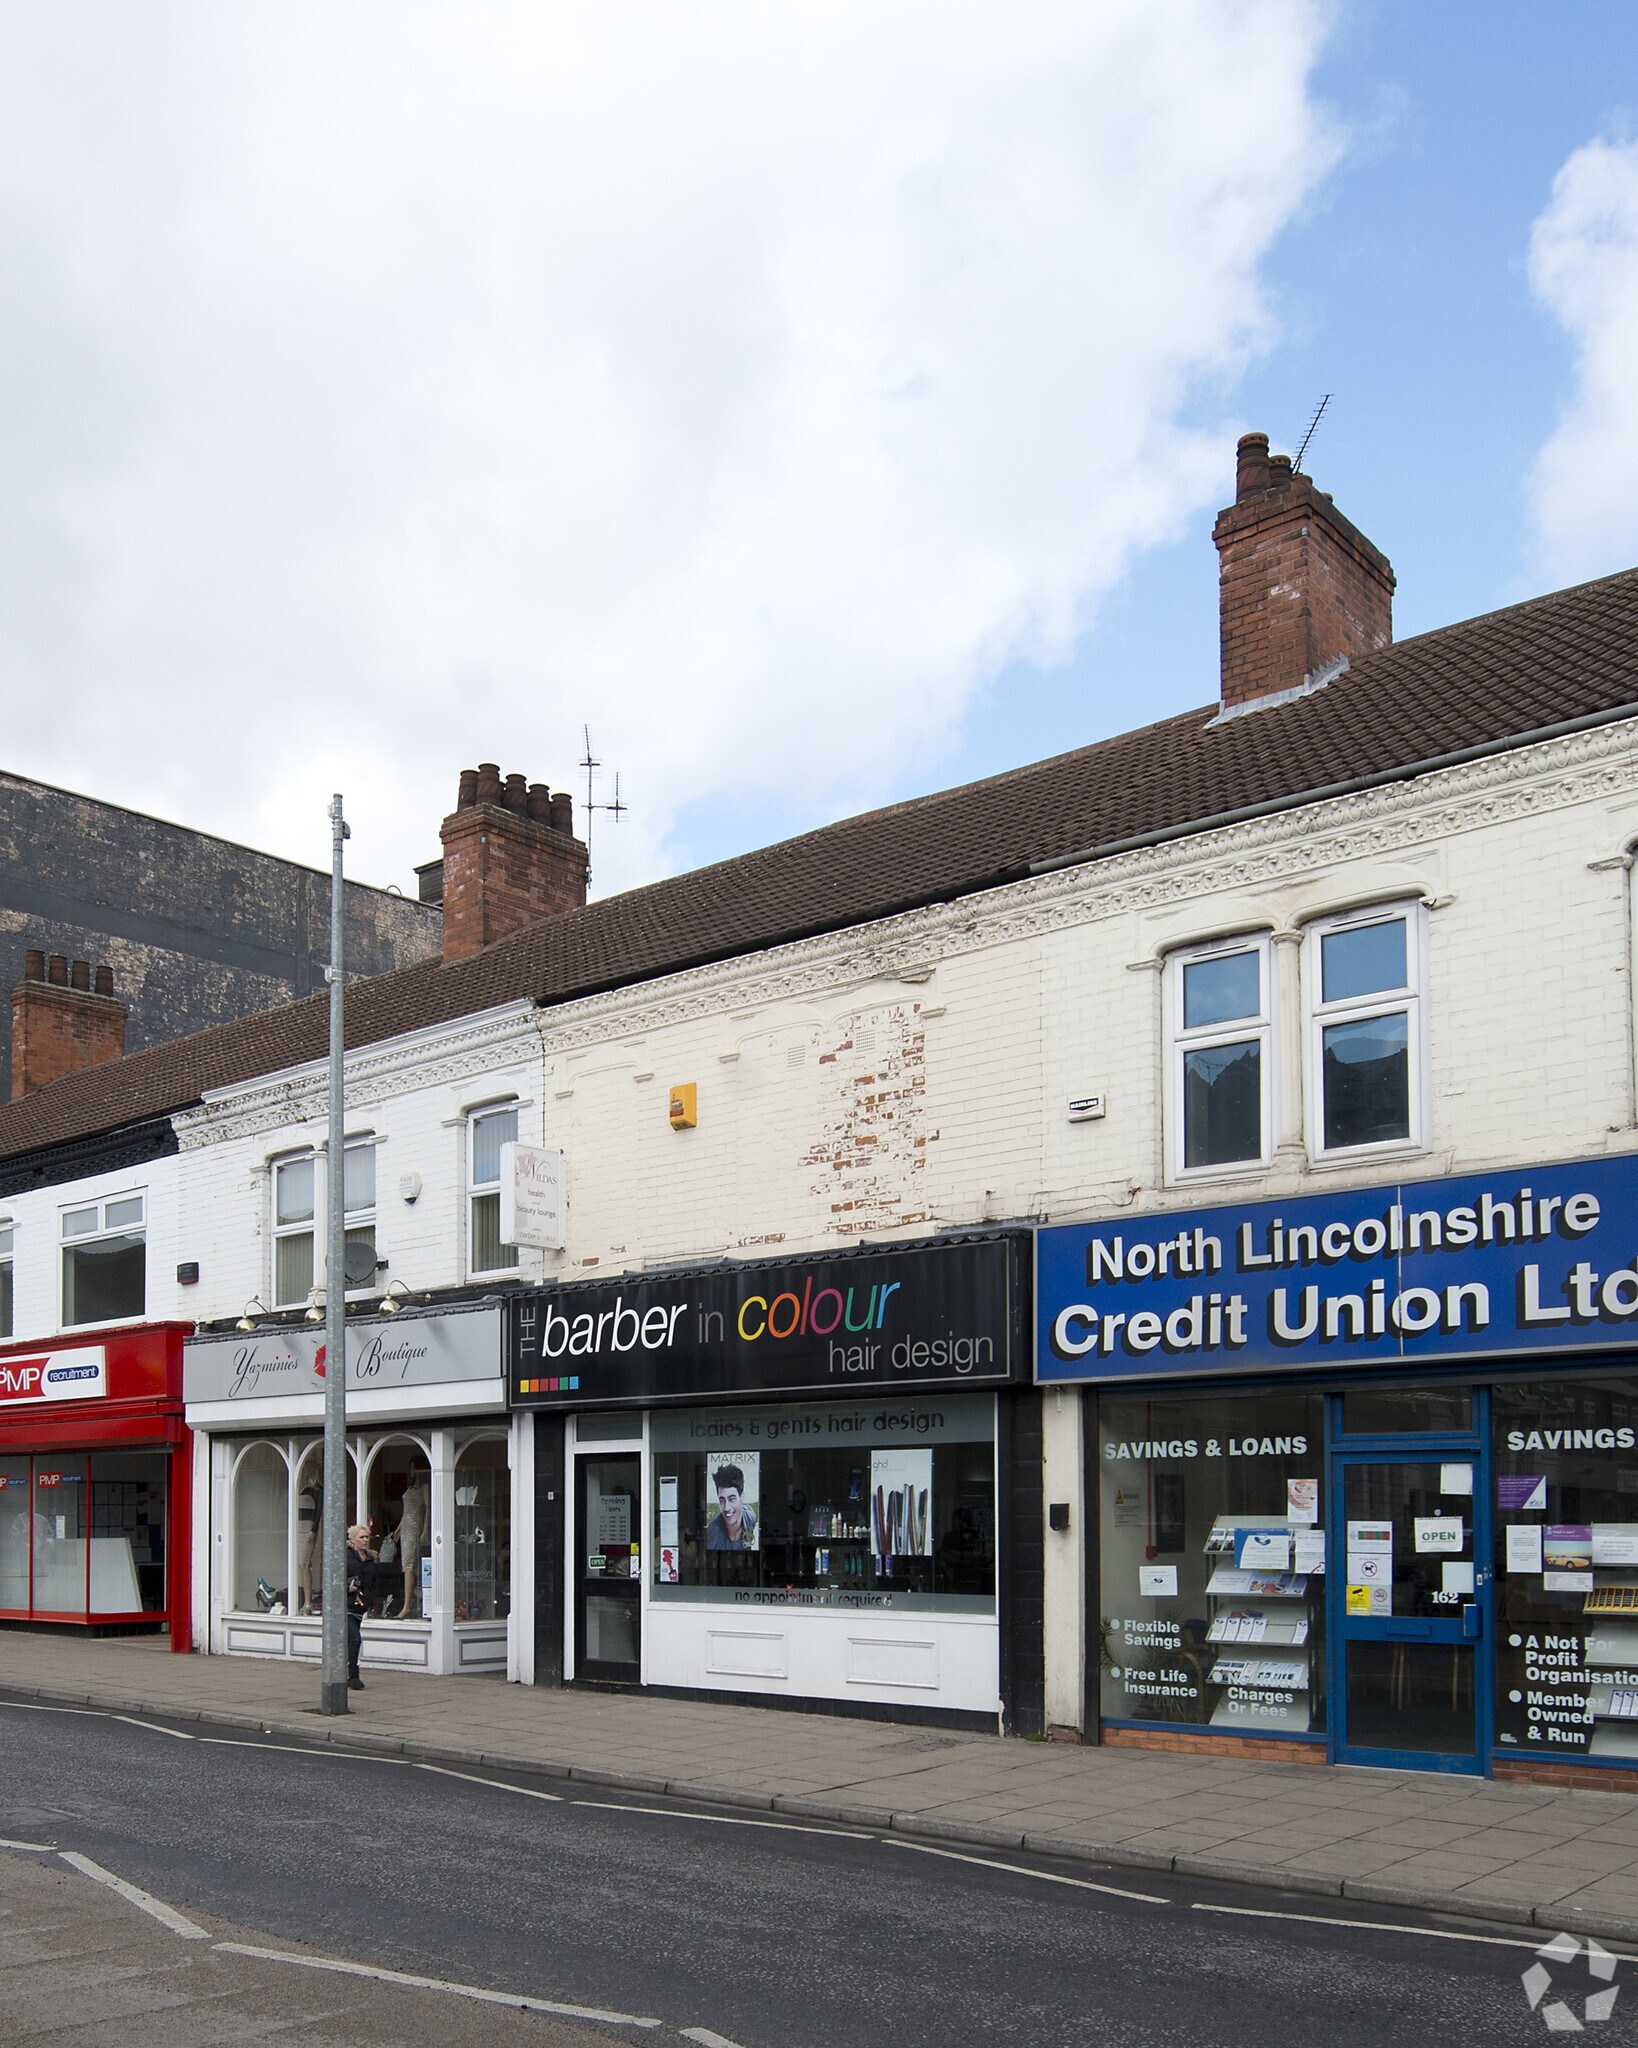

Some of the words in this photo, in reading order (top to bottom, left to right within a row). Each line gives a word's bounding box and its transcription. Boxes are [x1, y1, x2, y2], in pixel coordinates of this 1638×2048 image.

[528, 1188, 545, 1198] health
[516, 1204, 537, 1216] beauty
[537, 1207, 557, 1219] lounge
[1092, 1227, 1222, 1280] North
[1242, 1187, 1600, 1266] Lincolnshire
[541, 1297, 688, 1358] barber
[698, 1302, 724, 1344] in
[737, 1276, 900, 1341] colour
[1055, 1293, 1248, 1354] Credit
[1273, 1281, 1490, 1340] Union
[520, 1306, 536, 1358] THE
[356, 1330, 428, 1378] Boutique
[829, 1337, 881, 1373] hair
[891, 1331, 994, 1374] design
[50, 1367, 96, 1381] recruitment
[690, 1419, 743, 1438] ladies
[767, 1416, 821, 1439] gents
[828, 1413, 866, 1433] hair
[873, 1409, 945, 1433] design
[1507, 1428, 1635, 1450] SAVINGS
[1104, 1440, 1198, 1460] SAVINGS
[1205, 1439, 1222, 1457] &
[1229, 1436, 1308, 1456] LOANS
[711, 1453, 755, 1463] MATRIX
[873, 1459, 889, 1472] ghd
[39, 1474, 60, 1485] PMP
[1422, 1532, 1456, 1541] OPEN
[735, 1591, 750, 1601] no
[838, 1593, 893, 1607] required
[1432, 1591, 1459, 1604] 162
[1124, 1619, 1181, 1634] Flexible
[1124, 1633, 1182, 1650] Savings
[1525, 1635, 1539, 1649] A
[1545, 1635, 1579, 1650] Not
[1584, 1636, 1617, 1652] For
[1525, 1651, 1579, 1666] Profit
[1124, 1667, 1157, 1681] Free
[1160, 1669, 1188, 1683] Life
[1124, 1681, 1198, 1698] Insurance
[1227, 1686, 1295, 1704] Charges
[1526, 1691, 1606, 1708] Member
[1228, 1701, 1247, 1714] Or
[1251, 1703, 1288, 1718] Fees
[1527, 1707, 1595, 1724] Owned
[1527, 1725, 1542, 1740] &
[1547, 1727, 1586, 1744] Run
